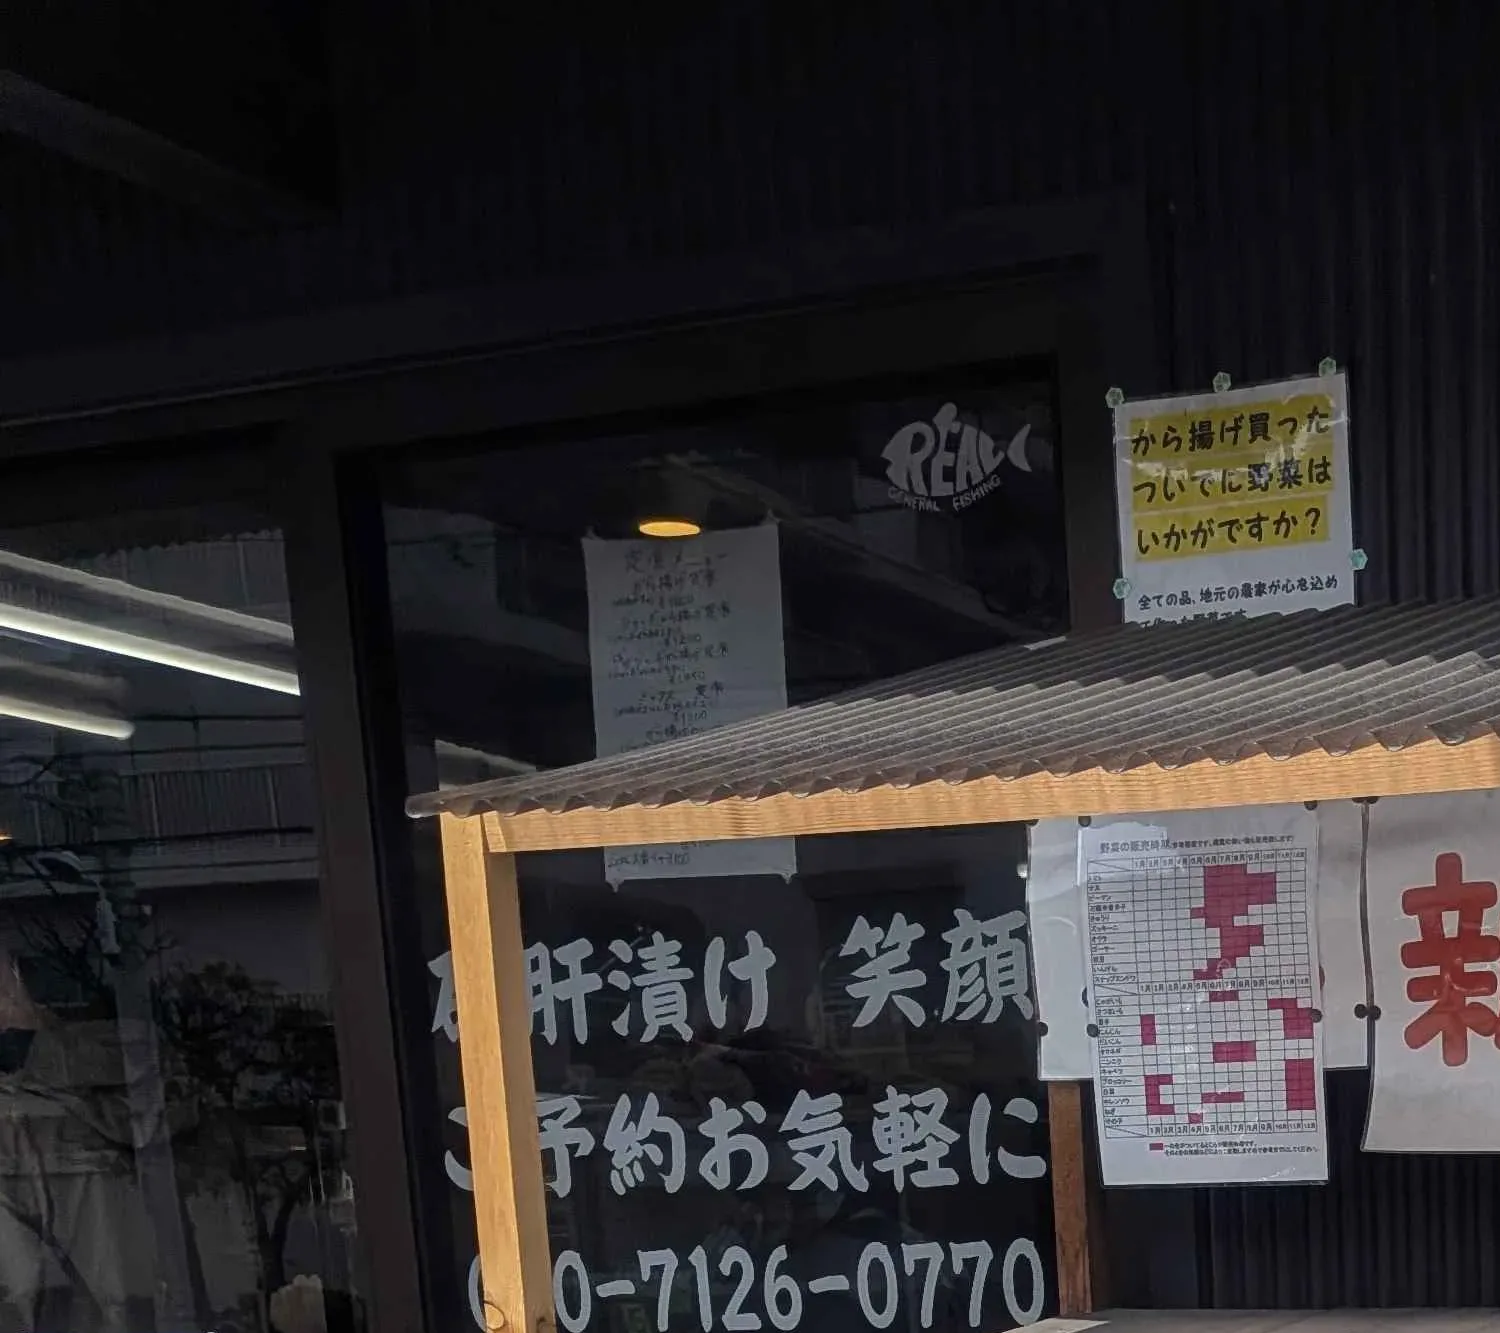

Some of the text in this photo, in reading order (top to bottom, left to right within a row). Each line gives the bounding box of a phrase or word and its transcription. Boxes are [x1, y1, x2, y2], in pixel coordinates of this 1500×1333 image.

[880, 402, 1005, 497] REAL
[1132, 405, 1329, 456] から揚げ買った
[952, 474, 1001, 512] FISHING
[1133, 455, 1332, 503] ついでに野菜は
[839, 907, 1034, 1028] 笑顔
